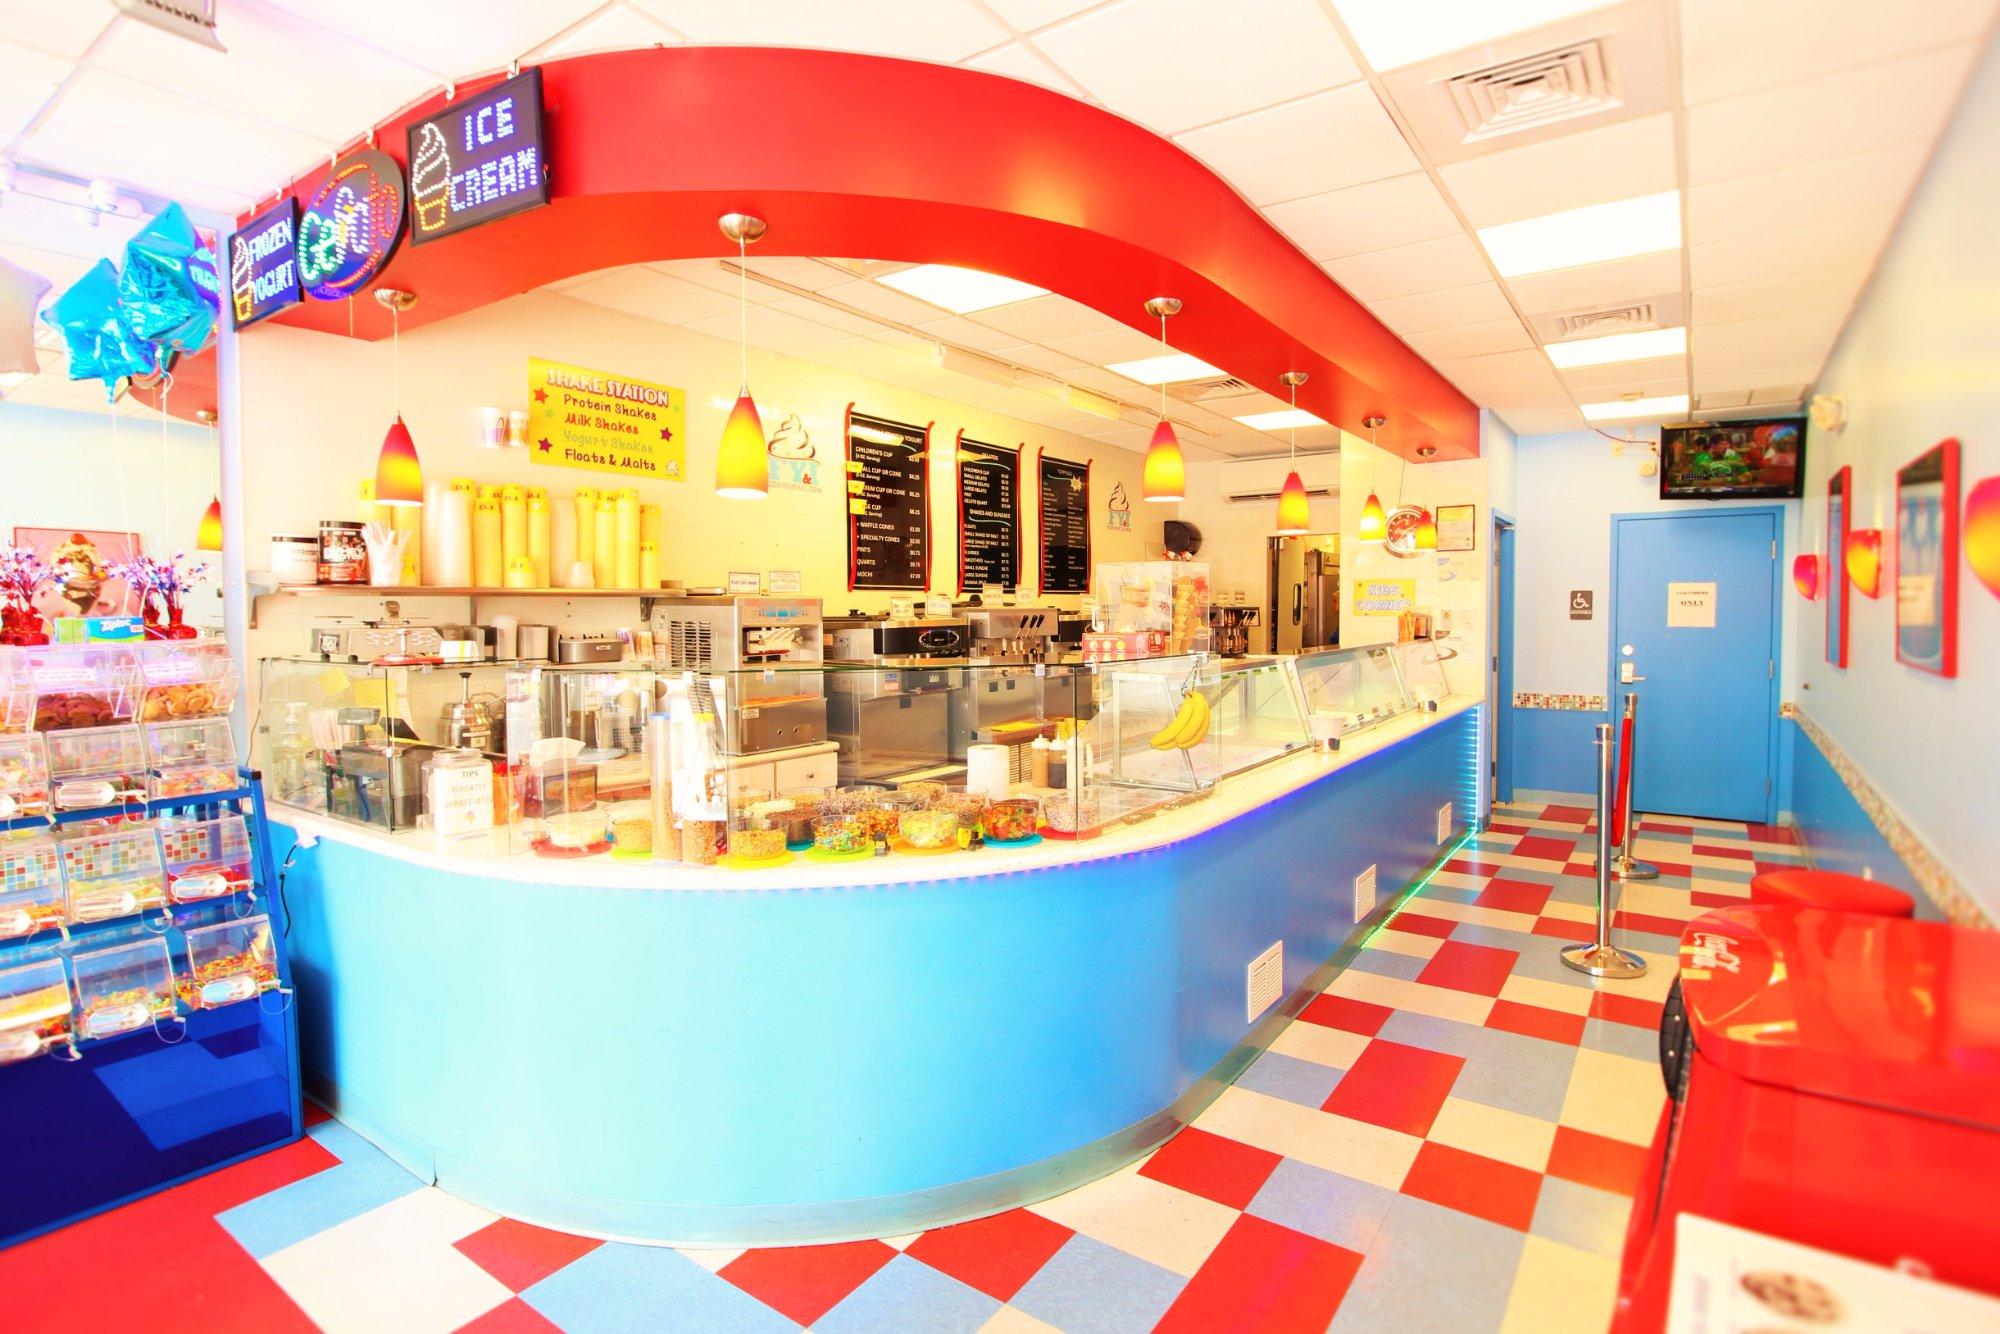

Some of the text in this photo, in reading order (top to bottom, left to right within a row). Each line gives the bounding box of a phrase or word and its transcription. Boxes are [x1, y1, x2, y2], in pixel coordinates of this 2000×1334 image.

[464, 97, 514, 151] ICE
[450, 146, 537, 212] CREAM
[248, 217, 293, 265] FROZEN
[251, 259, 294, 304] YOGURT
[547, 369, 669, 408] SHAKE STATION
[563, 393, 657, 421] Protein Shakes
[564, 413, 639, 435] Milk Shakes
[563, 430, 607, 447] Yogurt
[565, 448, 656, 471] Floats & Malts
[879, 523, 895, 531] CONES
[1367, 583, 1400, 596] KIDS
[1356, 599, 1411, 611] CORNER
[100, 618, 131, 632] Ziploc
[462, 770, 479, 778] TIPS
